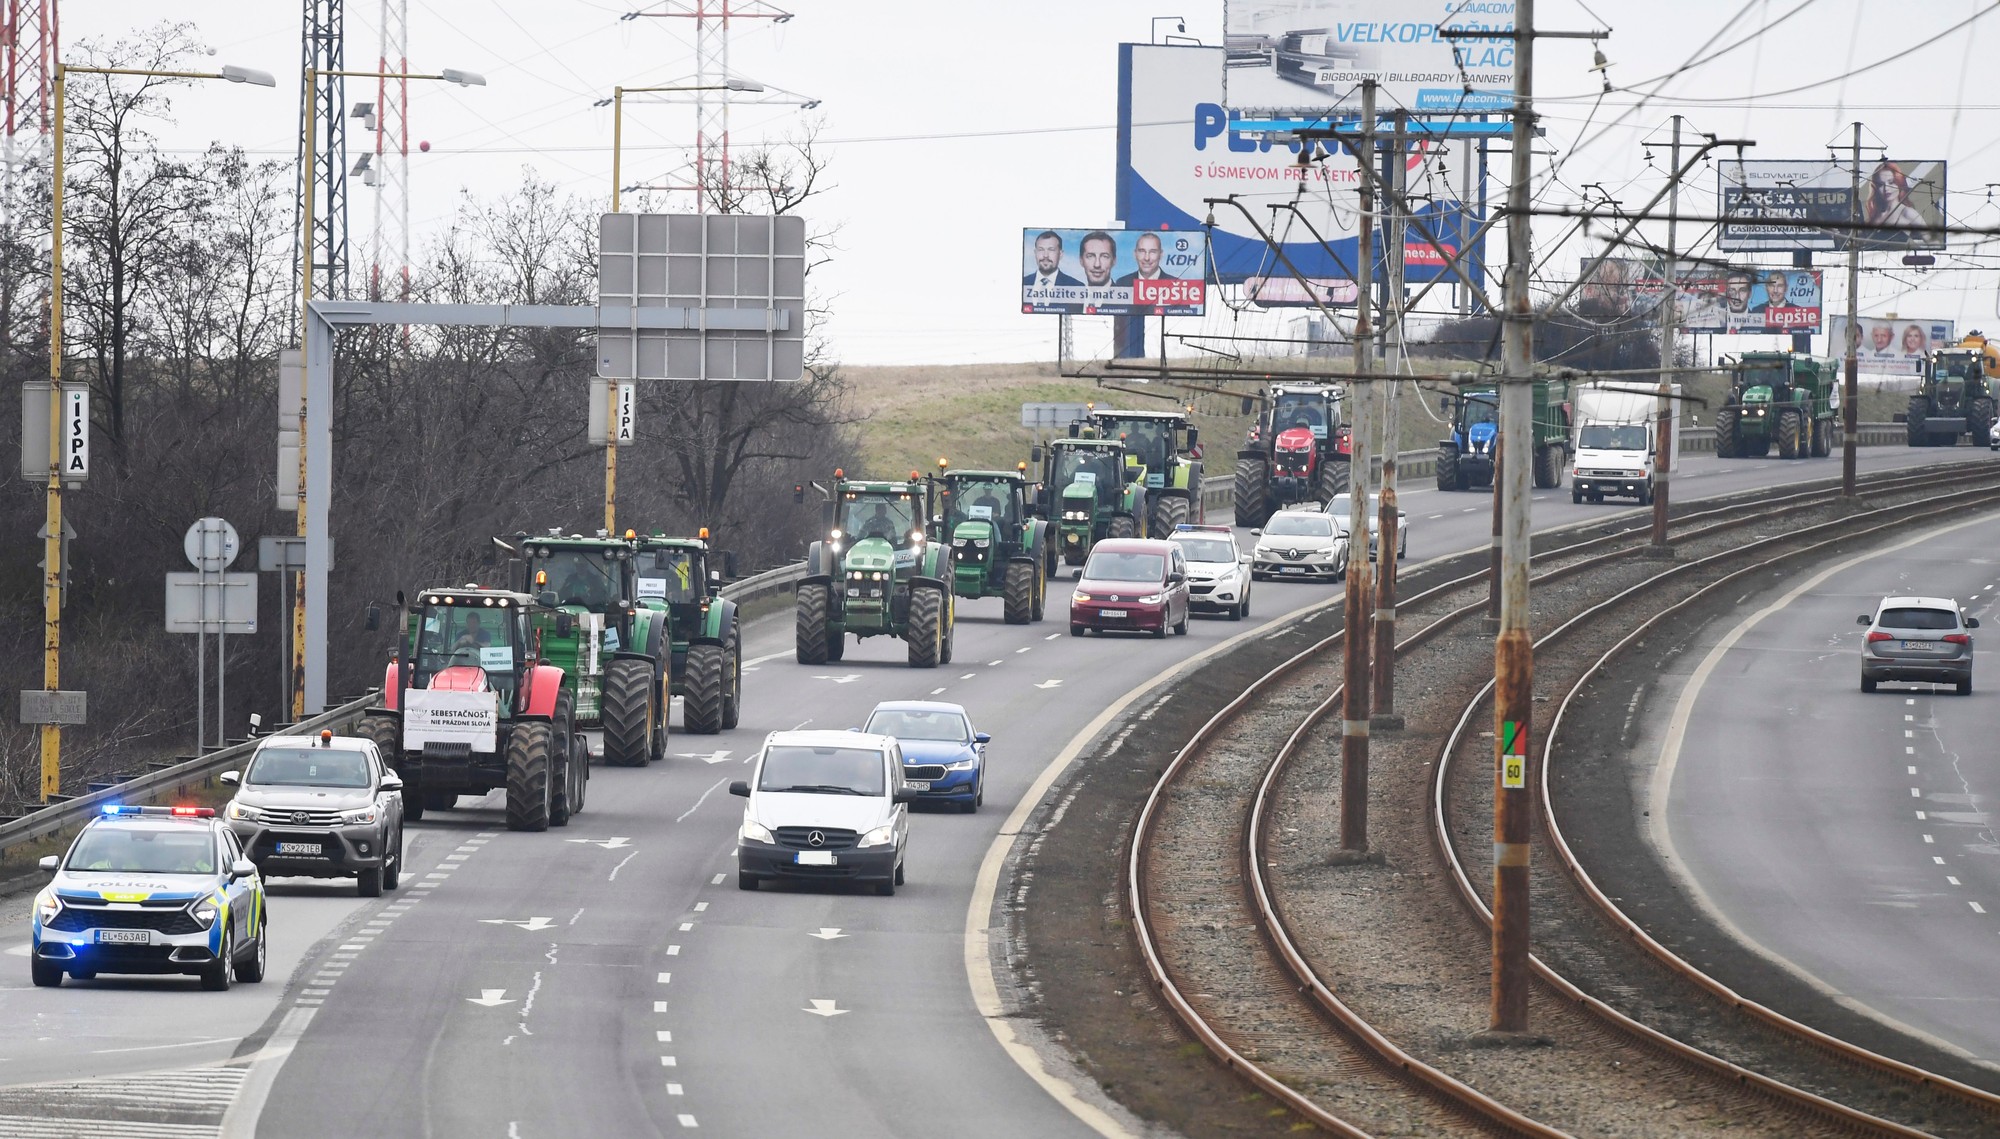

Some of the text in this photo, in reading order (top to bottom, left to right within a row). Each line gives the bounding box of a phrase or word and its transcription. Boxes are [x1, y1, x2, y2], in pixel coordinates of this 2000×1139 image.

[1458, 2, 1515, 14] LAVACOM
[1321, 72, 1514, 84] BIGBOARDY BILLBOARDY BANNERY
[1423, 93, 1514, 104] www.lavacom.sk
[1194, 166, 1203, 178] S
[1208, 161, 1279, 180] ÚSMEVOM
[1284, 169, 1310, 182] PRE
[1749, 172, 1809, 180] SLOVMATIC
[1817, 192, 1847, 205] EUR
[1177, 241, 1188, 250] 23
[1166, 253, 1199, 267] KDH
[1026, 288, 1129, 300] Zaslúžite si mať sa
[1138, 281, 1201, 306] lepšie
[1789, 287, 1815, 297] KDH
[1769, 308, 1817, 328] lepšie
[1507, 764, 1521, 779] 60
